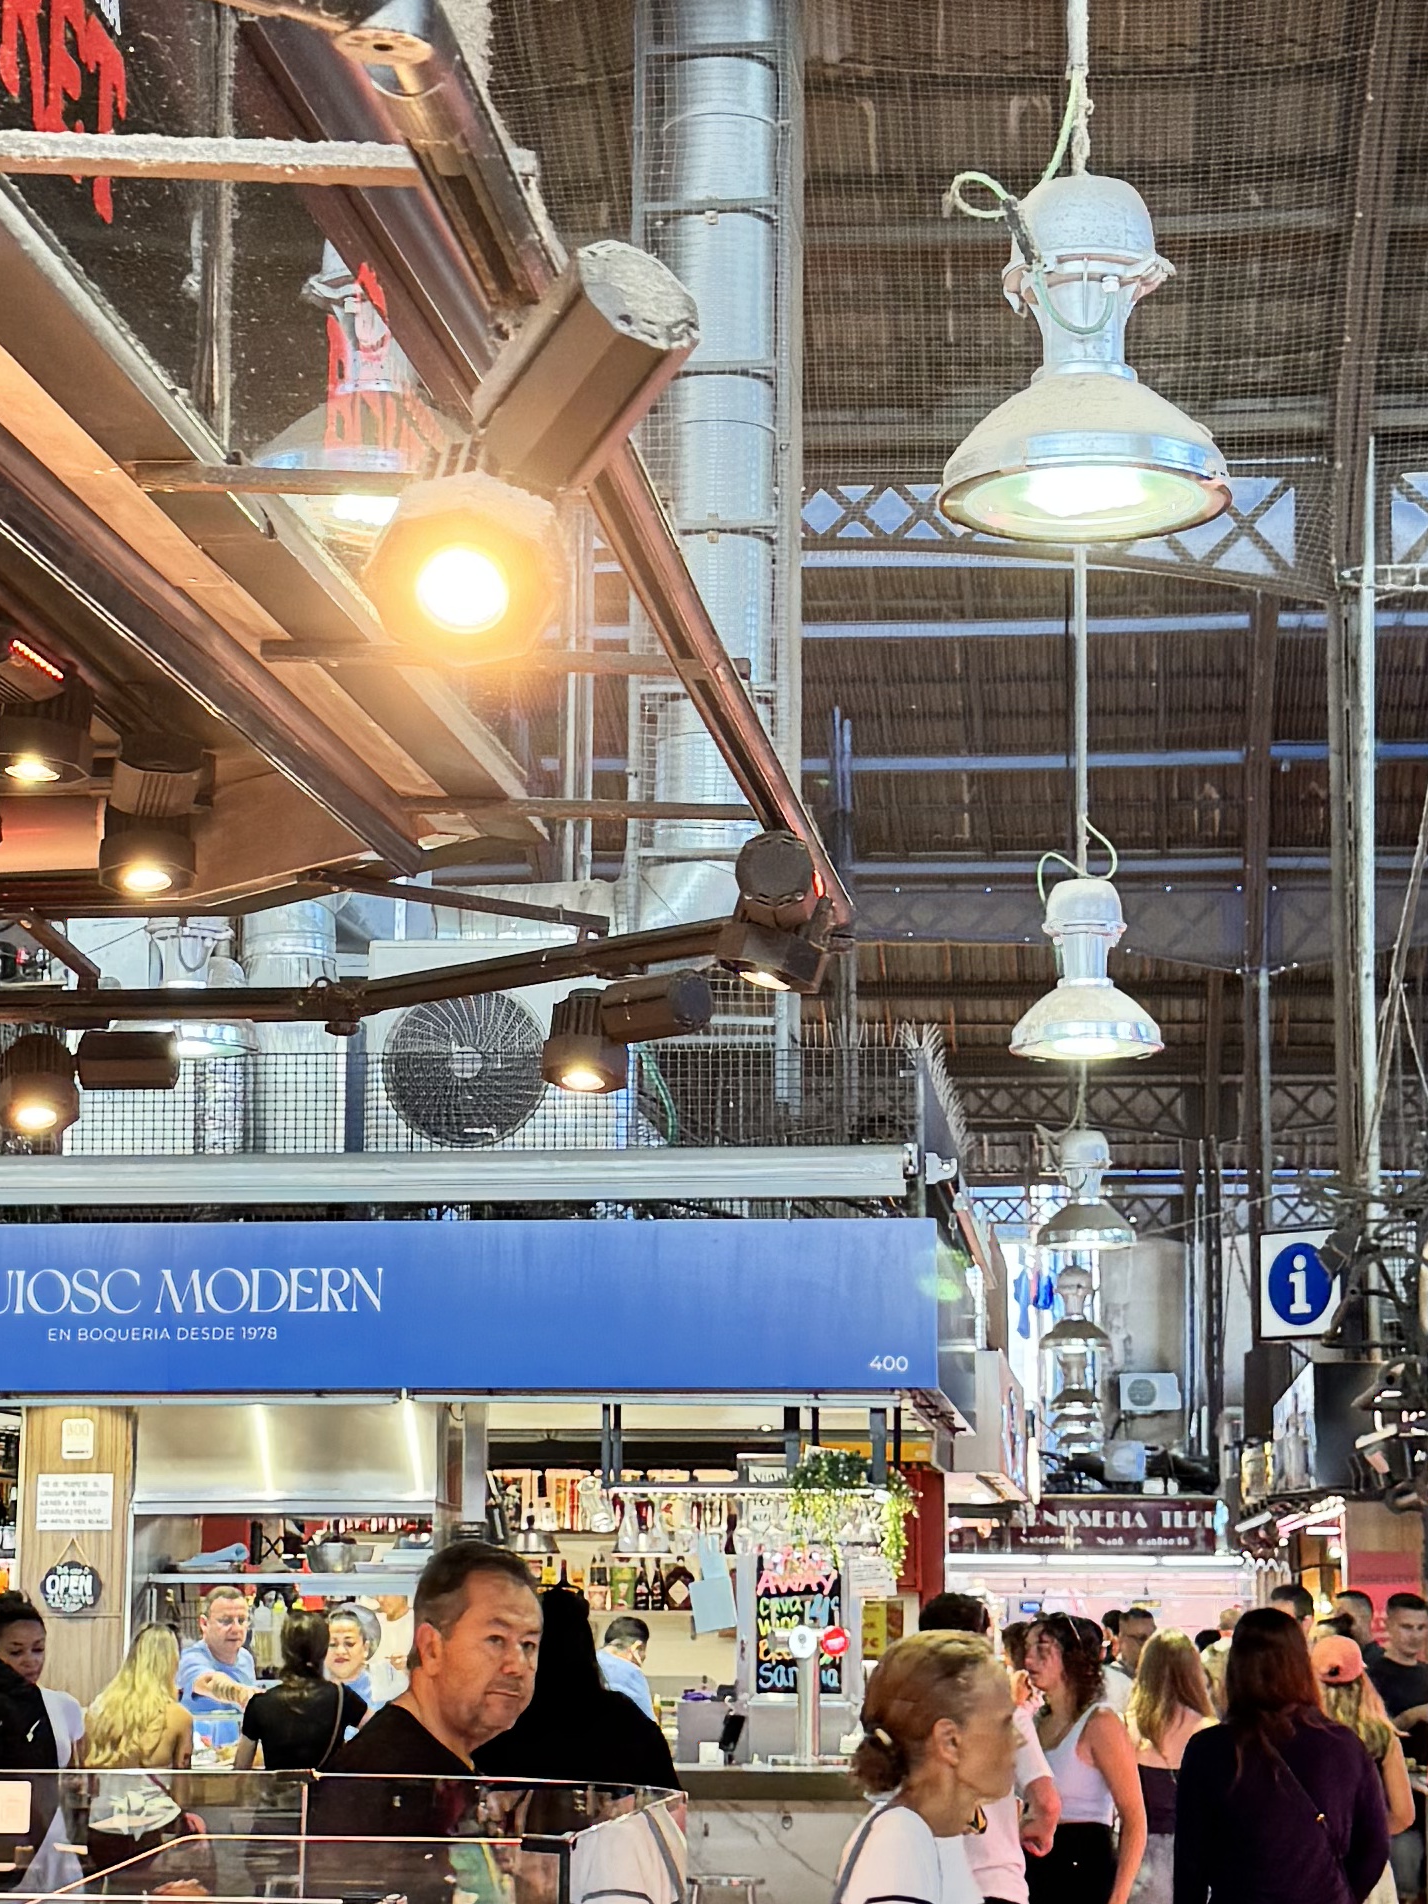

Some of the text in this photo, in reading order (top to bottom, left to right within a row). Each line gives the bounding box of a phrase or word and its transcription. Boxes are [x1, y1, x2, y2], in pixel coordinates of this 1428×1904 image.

[154, 1266, 384, 1315] MODERN
[48, 1325, 277, 1342] EN BOQUERIA DESDE 1978
[869, 1355, 909, 1372] 400
[45, 1574, 93, 1597] OPEN
